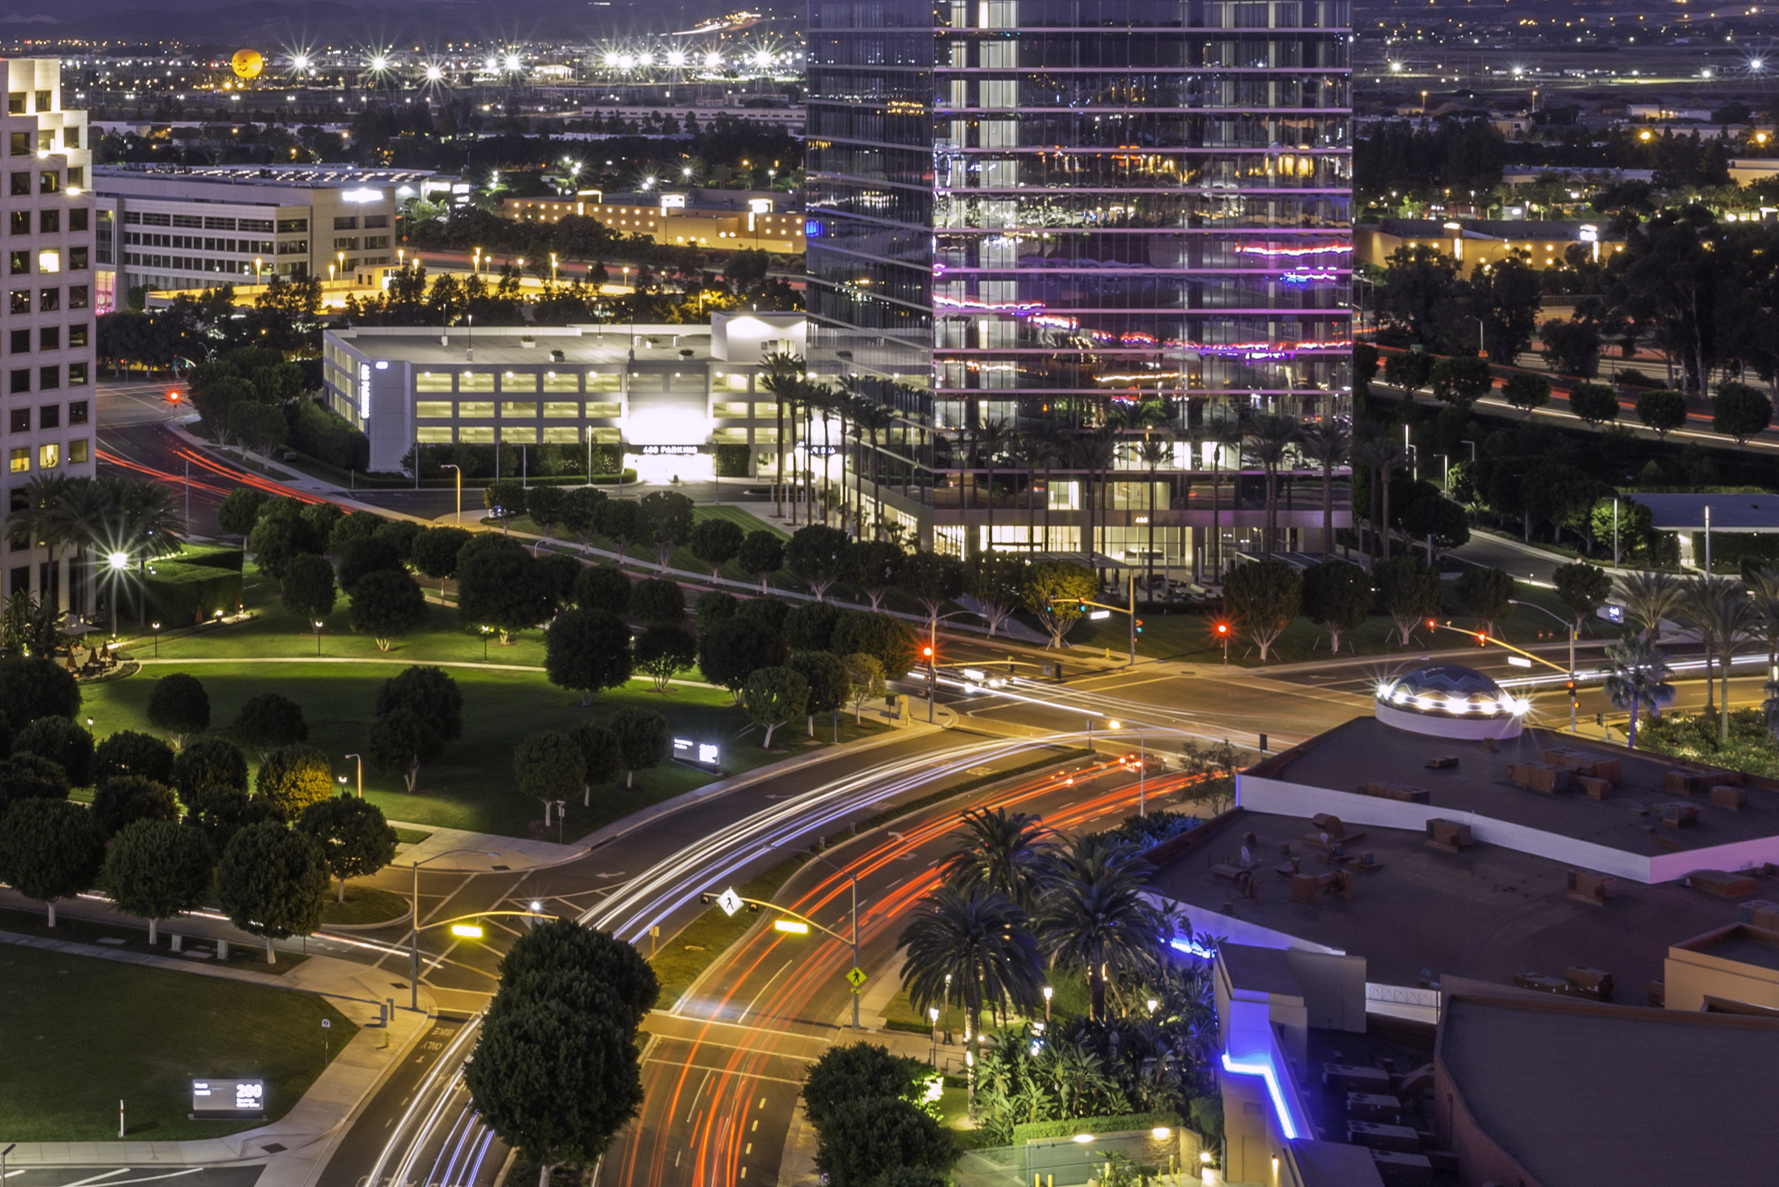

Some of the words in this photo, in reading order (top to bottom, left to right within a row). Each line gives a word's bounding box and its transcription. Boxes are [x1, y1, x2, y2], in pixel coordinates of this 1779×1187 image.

[431, 1027, 455, 1036] BIKE
[420, 1041, 443, 1051] ONLY
[236, 1083, 263, 1098] 200
